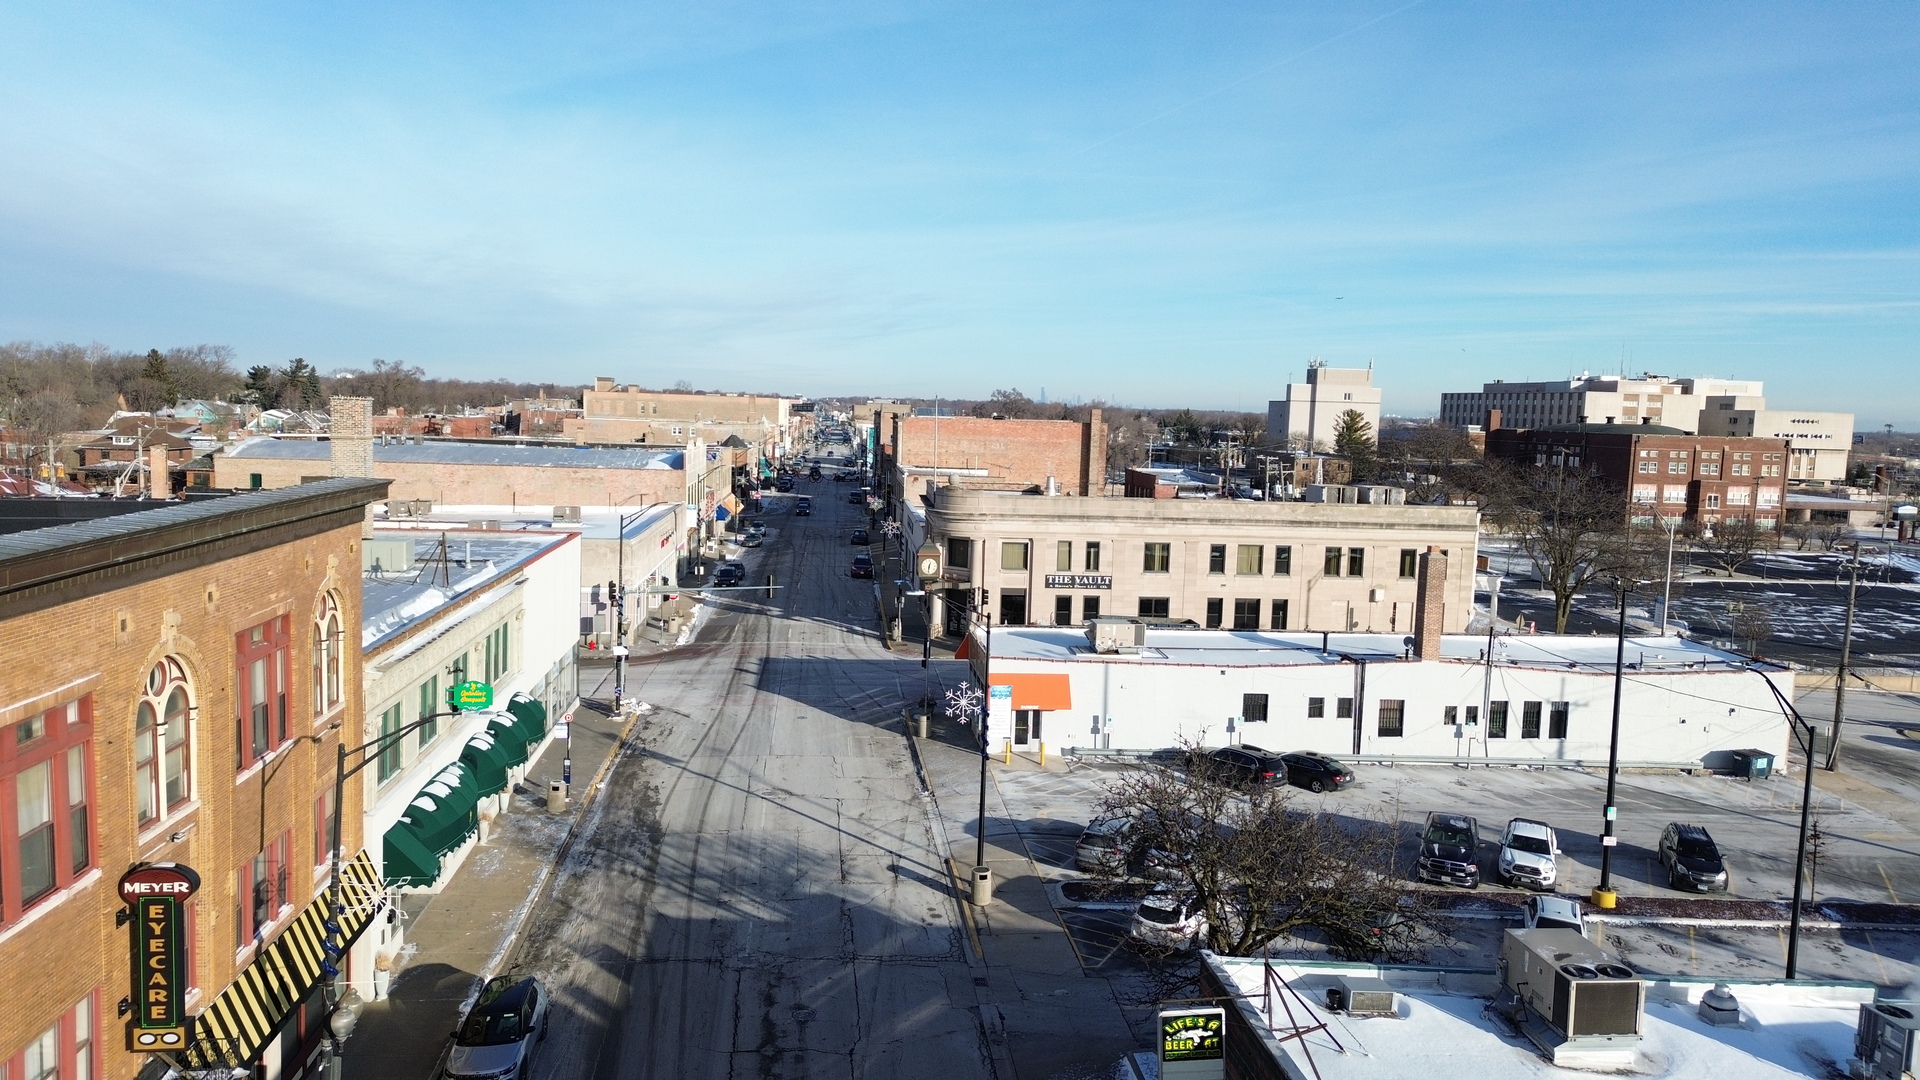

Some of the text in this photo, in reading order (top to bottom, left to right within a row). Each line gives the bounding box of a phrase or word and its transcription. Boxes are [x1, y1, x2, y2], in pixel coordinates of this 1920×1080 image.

[1047, 575, 1111, 584] THE VAULT
[124, 881, 190, 894] MEYER
[148, 905, 168, 1019] EYECARE
[1164, 1017, 1220, 1033] LIFE'S A
[1165, 1038, 1219, 1050] BEER AT
